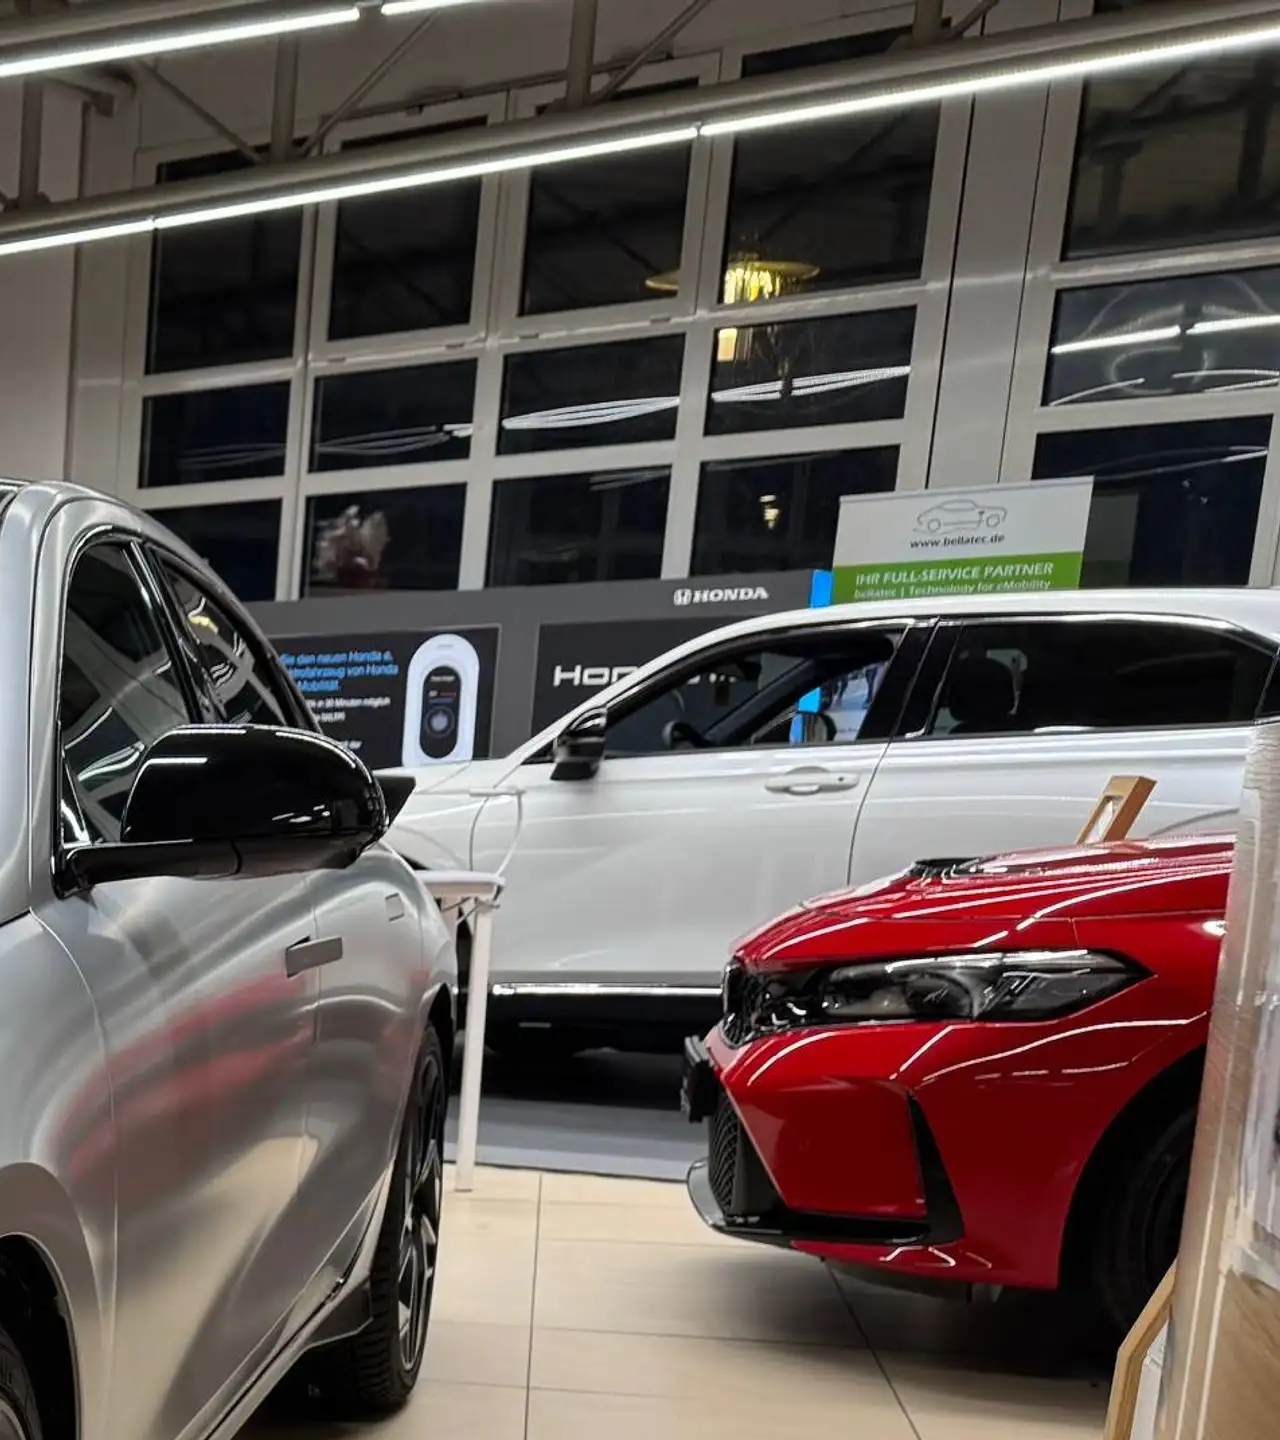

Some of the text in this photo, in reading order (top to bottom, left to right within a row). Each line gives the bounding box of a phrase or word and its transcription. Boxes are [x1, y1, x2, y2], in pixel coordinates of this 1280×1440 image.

[855, 561, 1055, 585] IHR FULL-SERVICE PARTNER
[693, 586, 770, 603] HONDA
[909, 582, 976, 597] Technology
[977, 581, 993, 592] for
[366, 664, 399, 676] Honda
